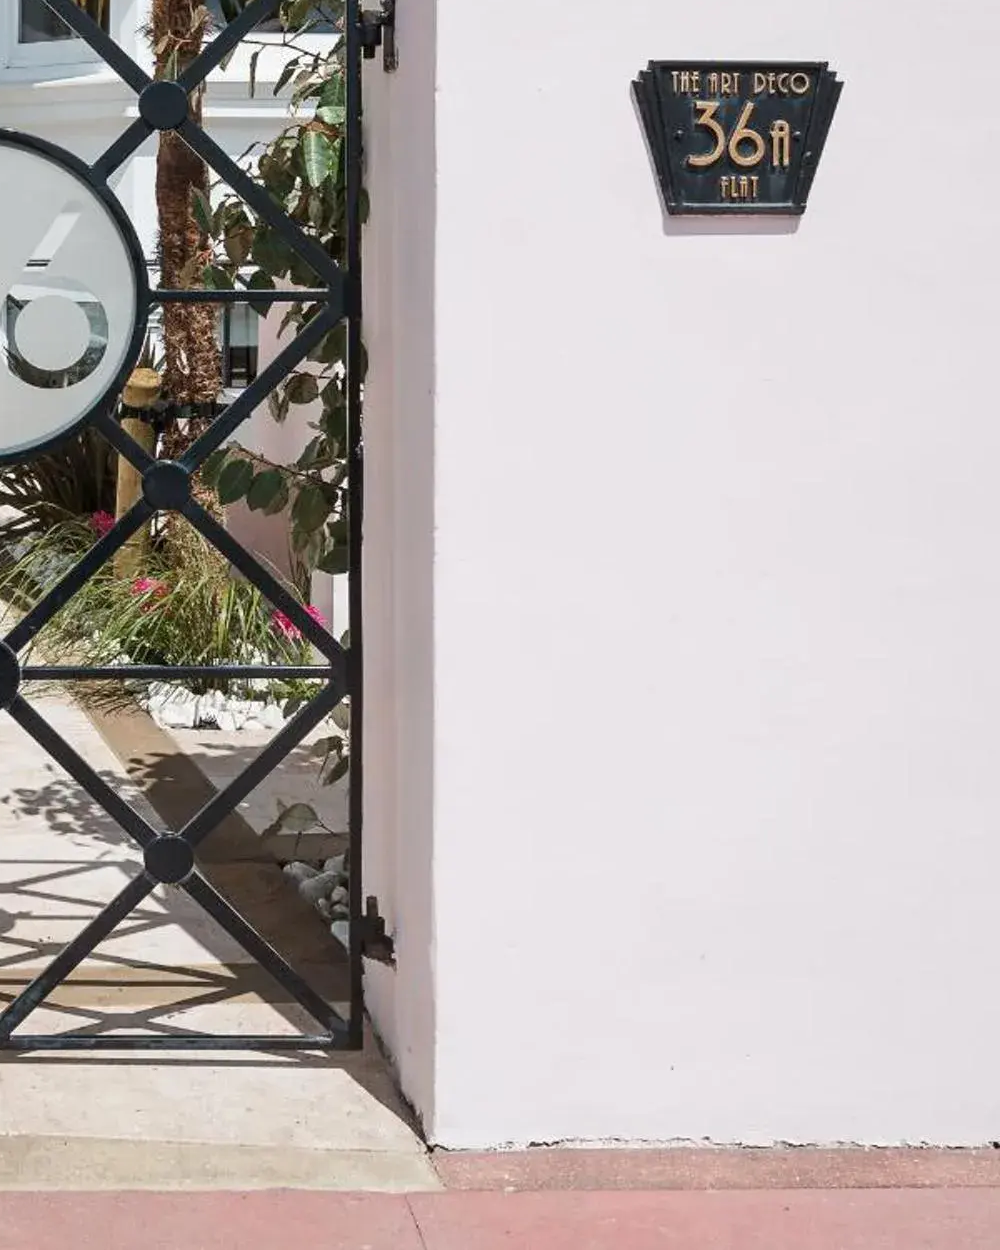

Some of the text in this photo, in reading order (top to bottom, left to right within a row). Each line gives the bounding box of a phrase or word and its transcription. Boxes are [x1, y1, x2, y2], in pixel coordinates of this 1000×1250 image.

[671, 71, 810, 94] THE ART DECO
[688, 100, 790, 166] 36A
[720, 176, 759, 197] FLAT
